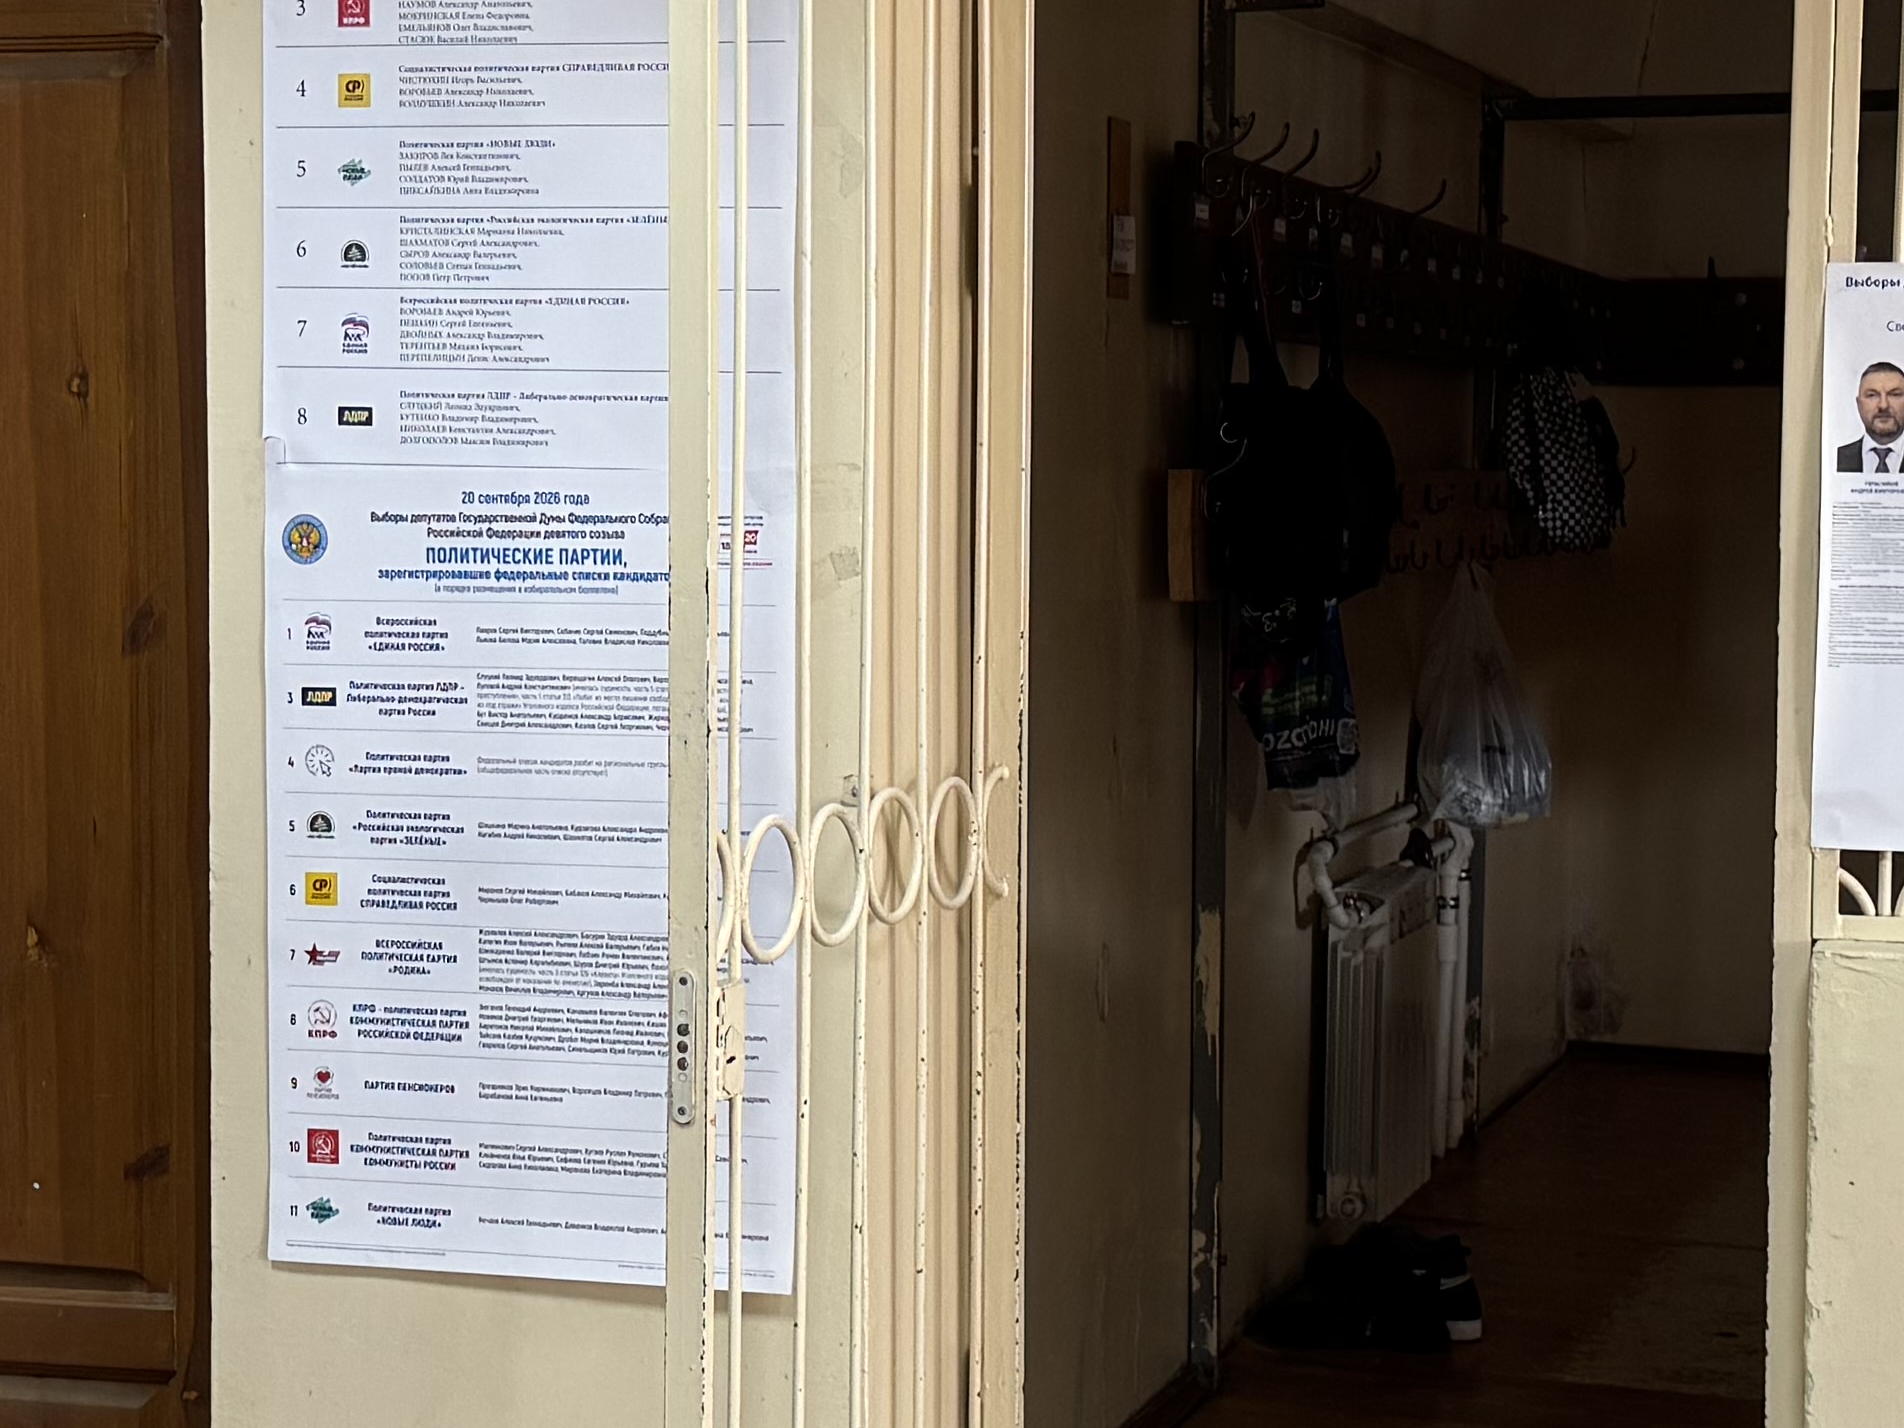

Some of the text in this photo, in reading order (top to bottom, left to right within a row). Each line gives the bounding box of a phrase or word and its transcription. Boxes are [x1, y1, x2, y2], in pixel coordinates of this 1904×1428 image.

[296, 0, 306, 16] 3
[296, 79, 306, 97] 4
[296, 160, 306, 177] 5
[296, 239, 307, 257] 6
[1845, 275, 1900, 290] Выборы
[297, 319, 307, 337] 7
[297, 407, 308, 425] 8
[461, 491, 475, 505] 20
[477, 491, 530, 508] сентября
[563, 494, 590, 507] года
[370, 511, 408, 526] Выборы
[425, 547, 627, 568] ПОЛИТИЧЕСКИЕ ПАРТИИ,
[287, 628, 292, 640] 1
[287, 692, 293, 704] 3
[288, 756, 295, 768] 4
[289, 820, 295, 832] 5
[289, 884, 296, 896] 6
[290, 949, 295, 961] 7
[291, 1077, 298, 1089] 9
[289, 1141, 300, 1152] 10
[290, 1205, 298, 1217] 11
